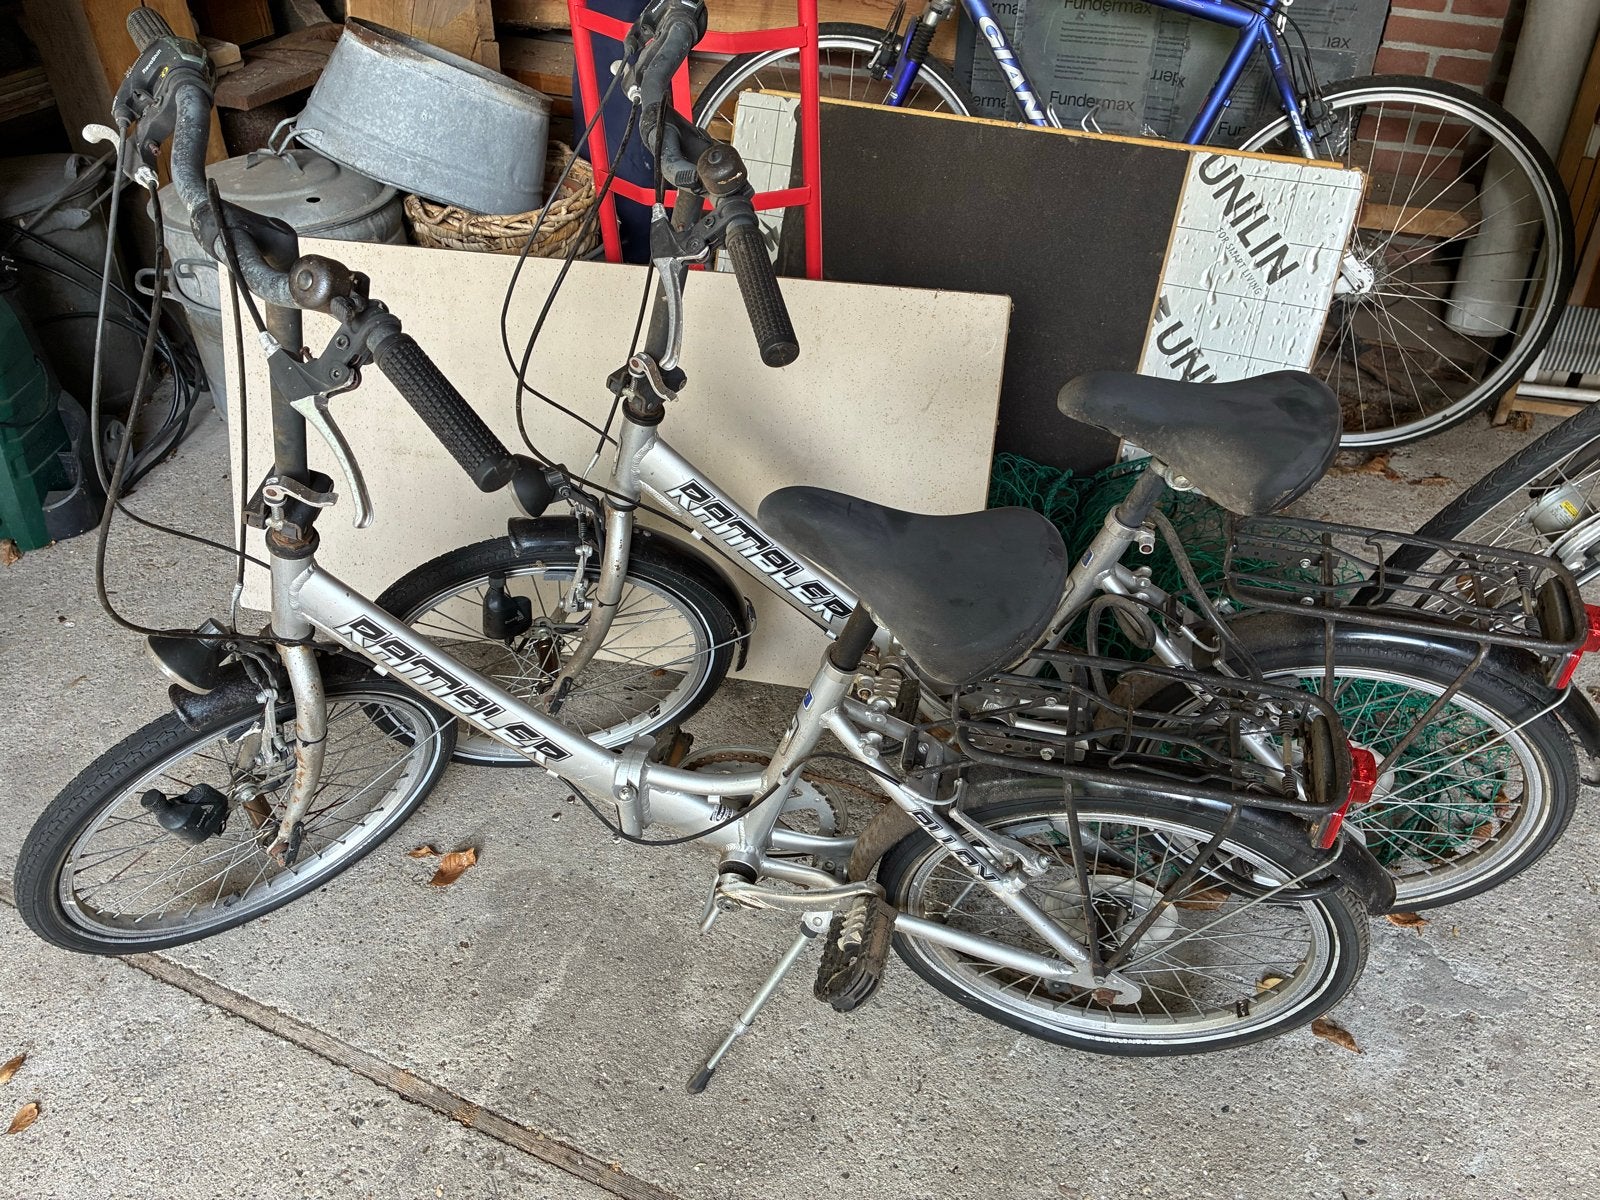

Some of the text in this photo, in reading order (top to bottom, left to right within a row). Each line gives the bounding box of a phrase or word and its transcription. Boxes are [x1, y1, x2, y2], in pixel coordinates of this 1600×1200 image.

[1063, 0, 1153, 14] Fundermax
[979, 16, 1048, 127] GIAN
[1049, 90, 1136, 112] Fundermax
[1199, 154, 1300, 285] UNILIN
[1216, 227, 1262, 295] FOR SMART LIVING
[664, 478, 854, 623] RAMBLER
[333, 614, 573, 765] RAMBLER
